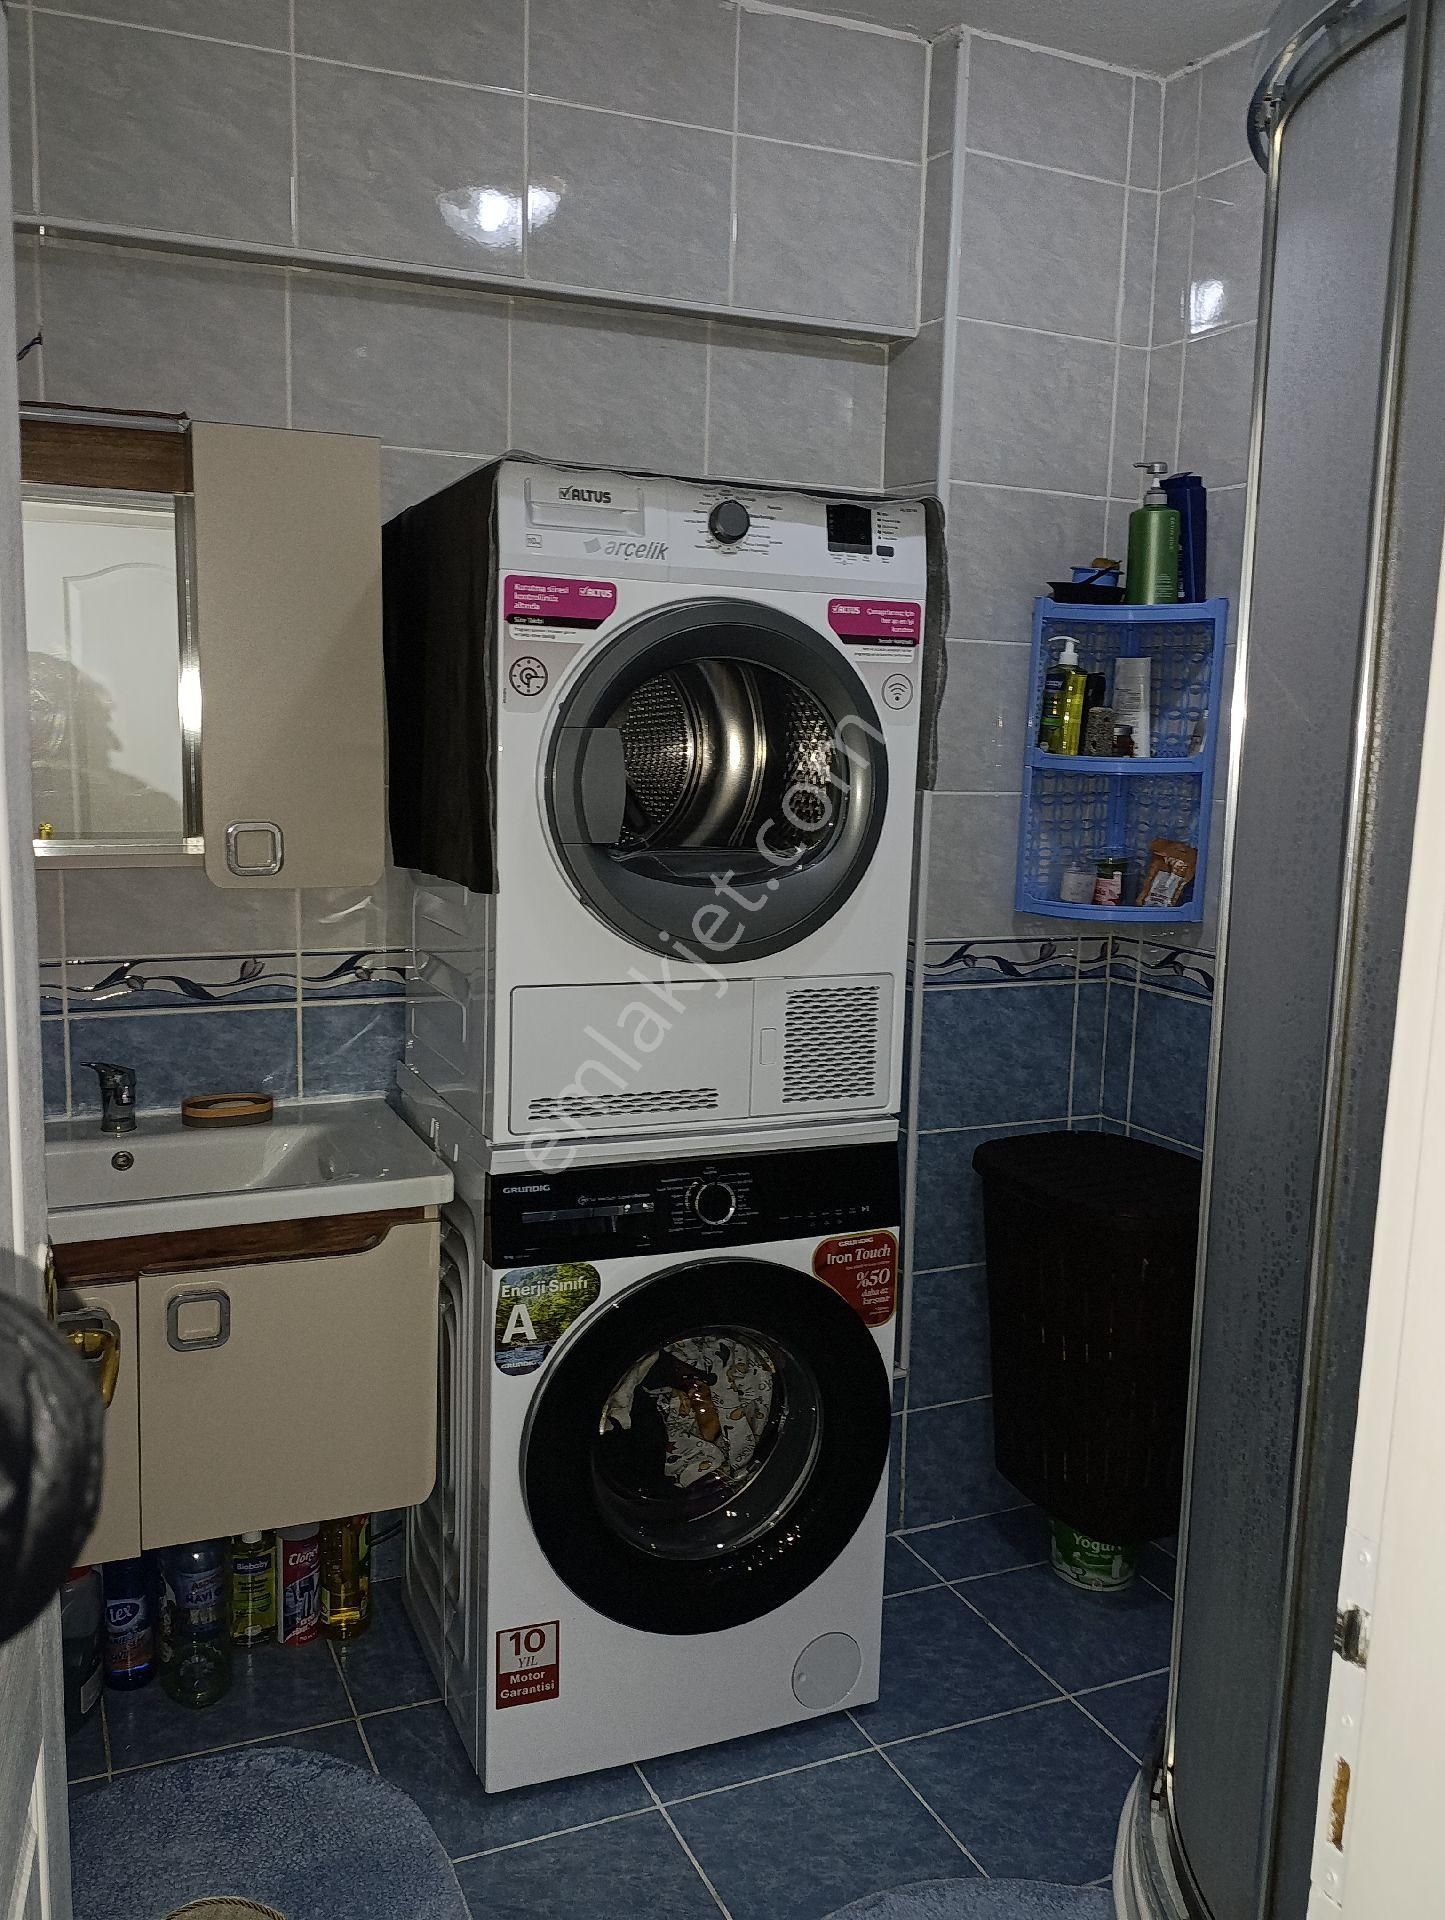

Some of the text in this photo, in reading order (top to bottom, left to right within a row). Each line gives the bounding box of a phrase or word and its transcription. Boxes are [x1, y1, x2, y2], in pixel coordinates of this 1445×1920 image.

[572, 488, 612, 504] ALTUS
[604, 540, 669, 561] arçelik
[502, 1184, 551, 1194] GRUNDIG
[826, 1244, 891, 1265] Iron Touch
[856, 1267, 891, 1289] %50
[501, 1280, 546, 1298] Enerji
[501, 1303, 538, 1344] A
[509, 1627, 546, 1656] 10
[518, 1655, 538, 1669] YIL
[509, 1671, 546, 1685] Motor
[500, 1679, 555, 1699] Garantisi
